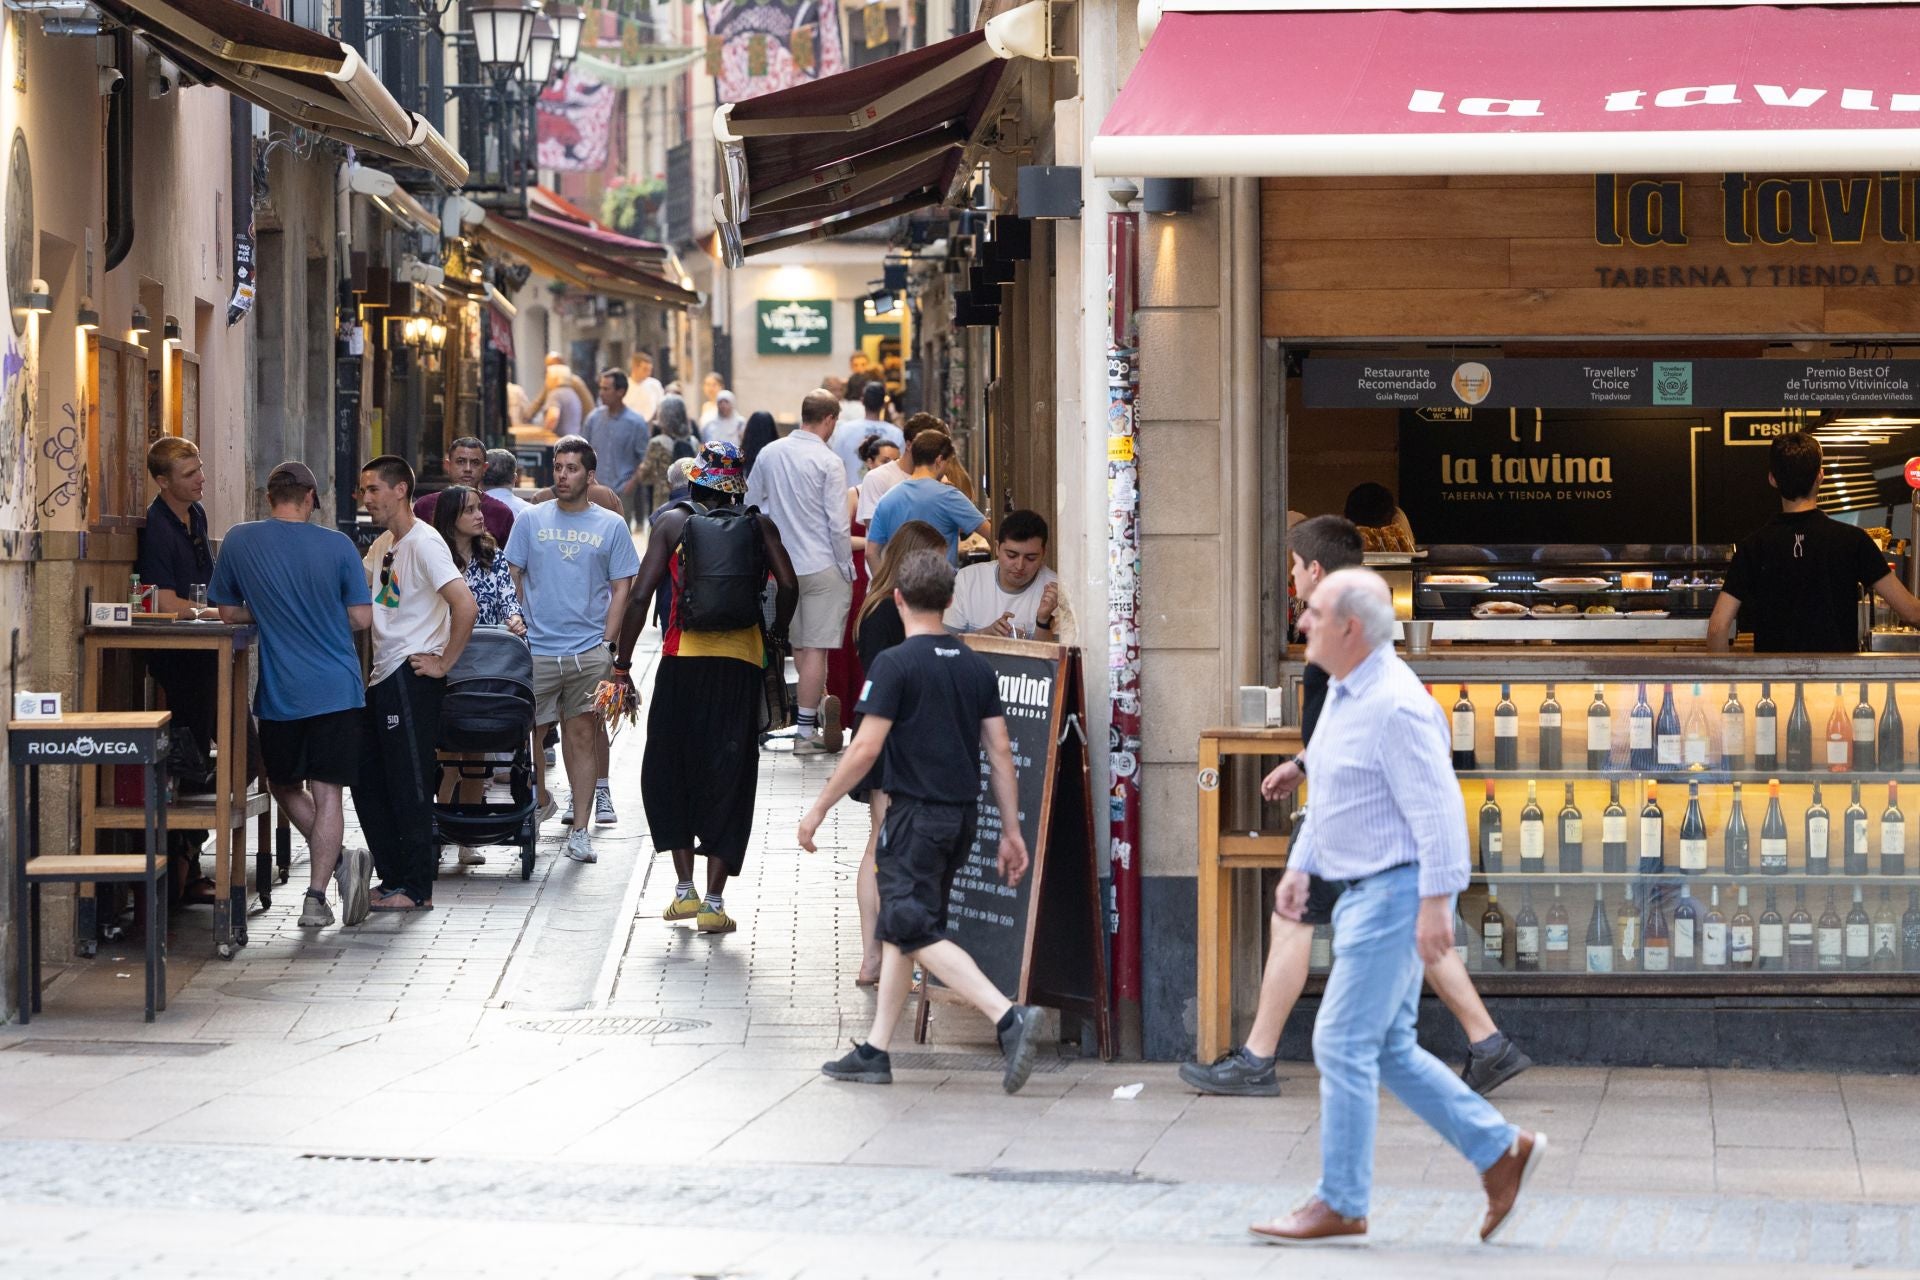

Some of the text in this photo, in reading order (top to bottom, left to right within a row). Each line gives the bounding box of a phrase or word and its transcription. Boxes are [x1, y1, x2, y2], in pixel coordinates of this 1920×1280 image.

[1407, 88, 1545, 117] la
[1593, 172, 1920, 248] la tavi
[1594, 264, 1920, 288] TABERNA Y TIENDA D
[1364, 367, 1431, 378] Restaurante
[1583, 366, 1639, 378] Travellers'
[1806, 366, 1891, 377] Premio Best Of
[1358, 379, 1437, 390] Recomendado
[1592, 378, 1630, 390] Choice
[1786, 378, 1909, 390] de Turismo Vitivinícola
[1375, 392, 1419, 402] Guía Repsol
[1590, 392, 1632, 402] Tripadvisor
[1783, 392, 1913, 402] Red de Capitales y Grandes Viñedos
[1432, 412, 1447, 420] WC
[1441, 453, 1613, 484] la tavina
[1441, 490, 1613, 500] TABERNA Y TIENDA DE VINOS
[537, 527, 604, 549] SILBON
[995, 670, 1053, 708] avina
[1006, 706, 1047, 720] COMIDAS
[28, 742, 139, 755] RIOJA VEGA
